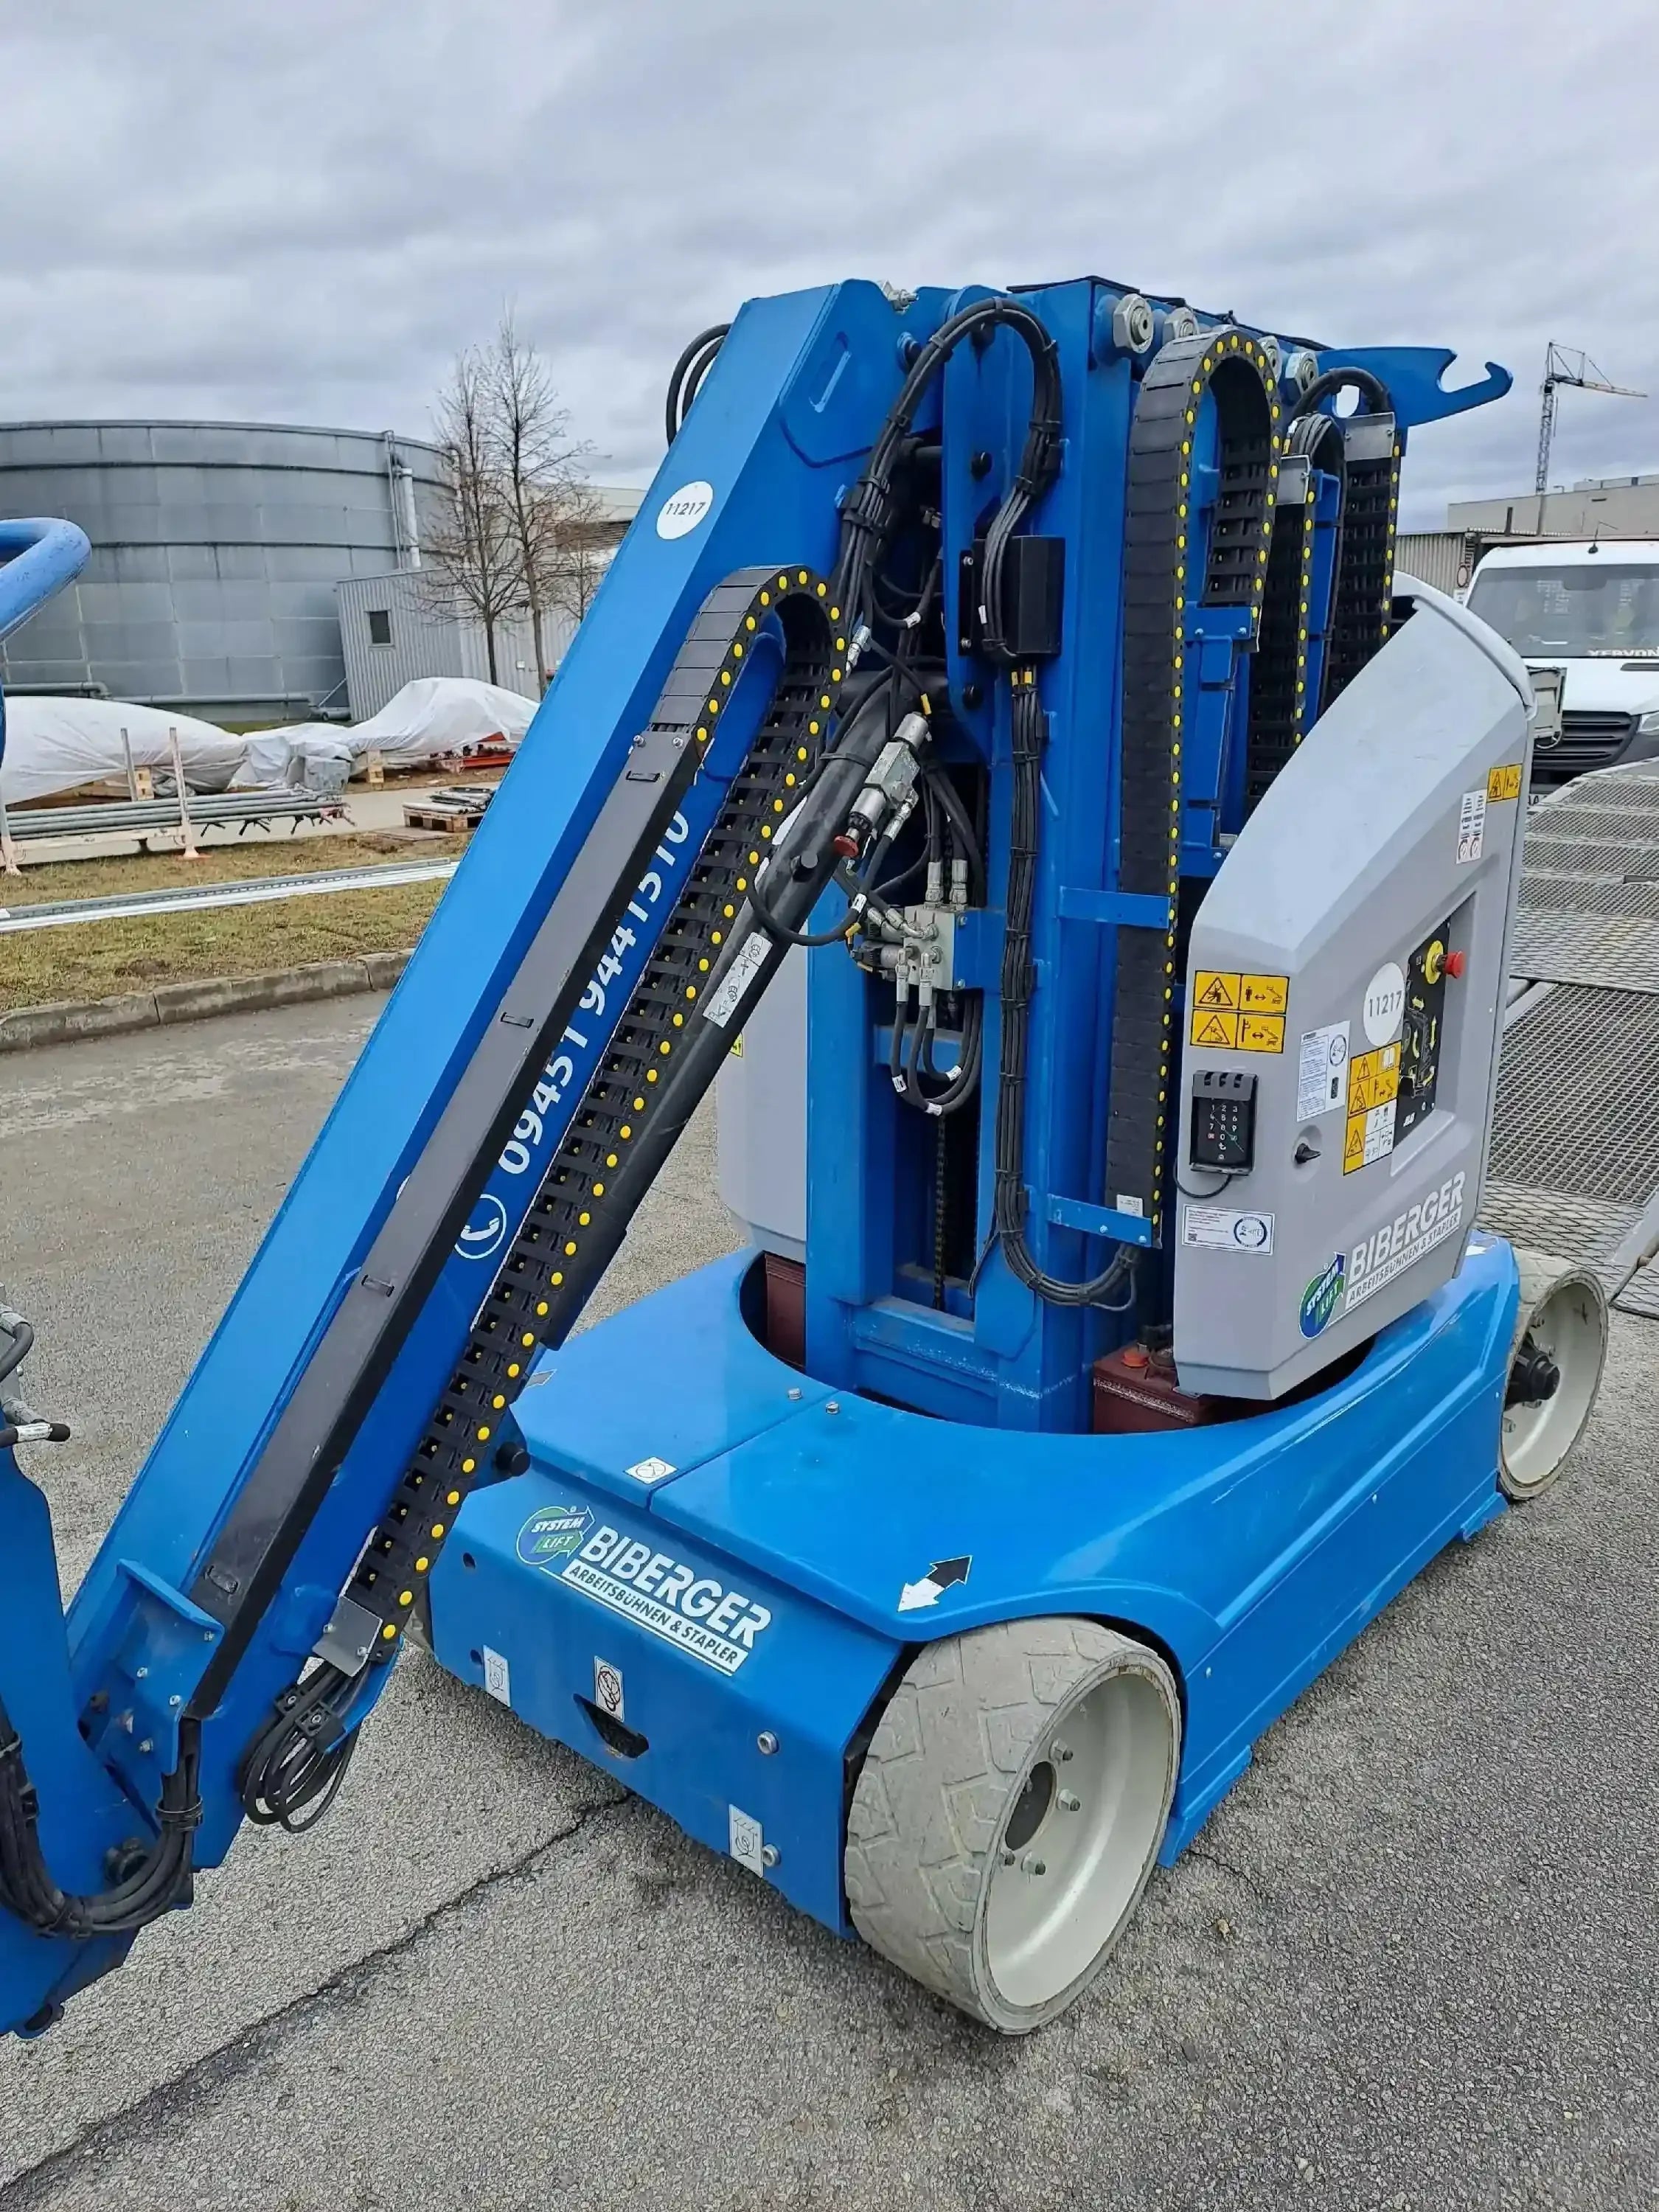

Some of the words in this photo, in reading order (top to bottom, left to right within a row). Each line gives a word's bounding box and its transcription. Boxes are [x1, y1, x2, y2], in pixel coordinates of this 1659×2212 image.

[666, 501, 706, 515] 11217
[498, 1026, 588, 1175] 09451
[579, 810, 689, 1016] 9441510
[1369, 990, 1402, 1018] 11217
[1348, 1171, 1466, 1286] BIBERGER
[531, 1517, 585, 1533] SYSTEM
[542, 1536, 574, 1548] LIFT
[569, 1564, 671, 1627] ARBEITSBÜHNEN
[669, 1620, 682, 1634] &
[681, 1627, 738, 1665] STAPLER
[579, 1525, 771, 1649] BIBERGER
